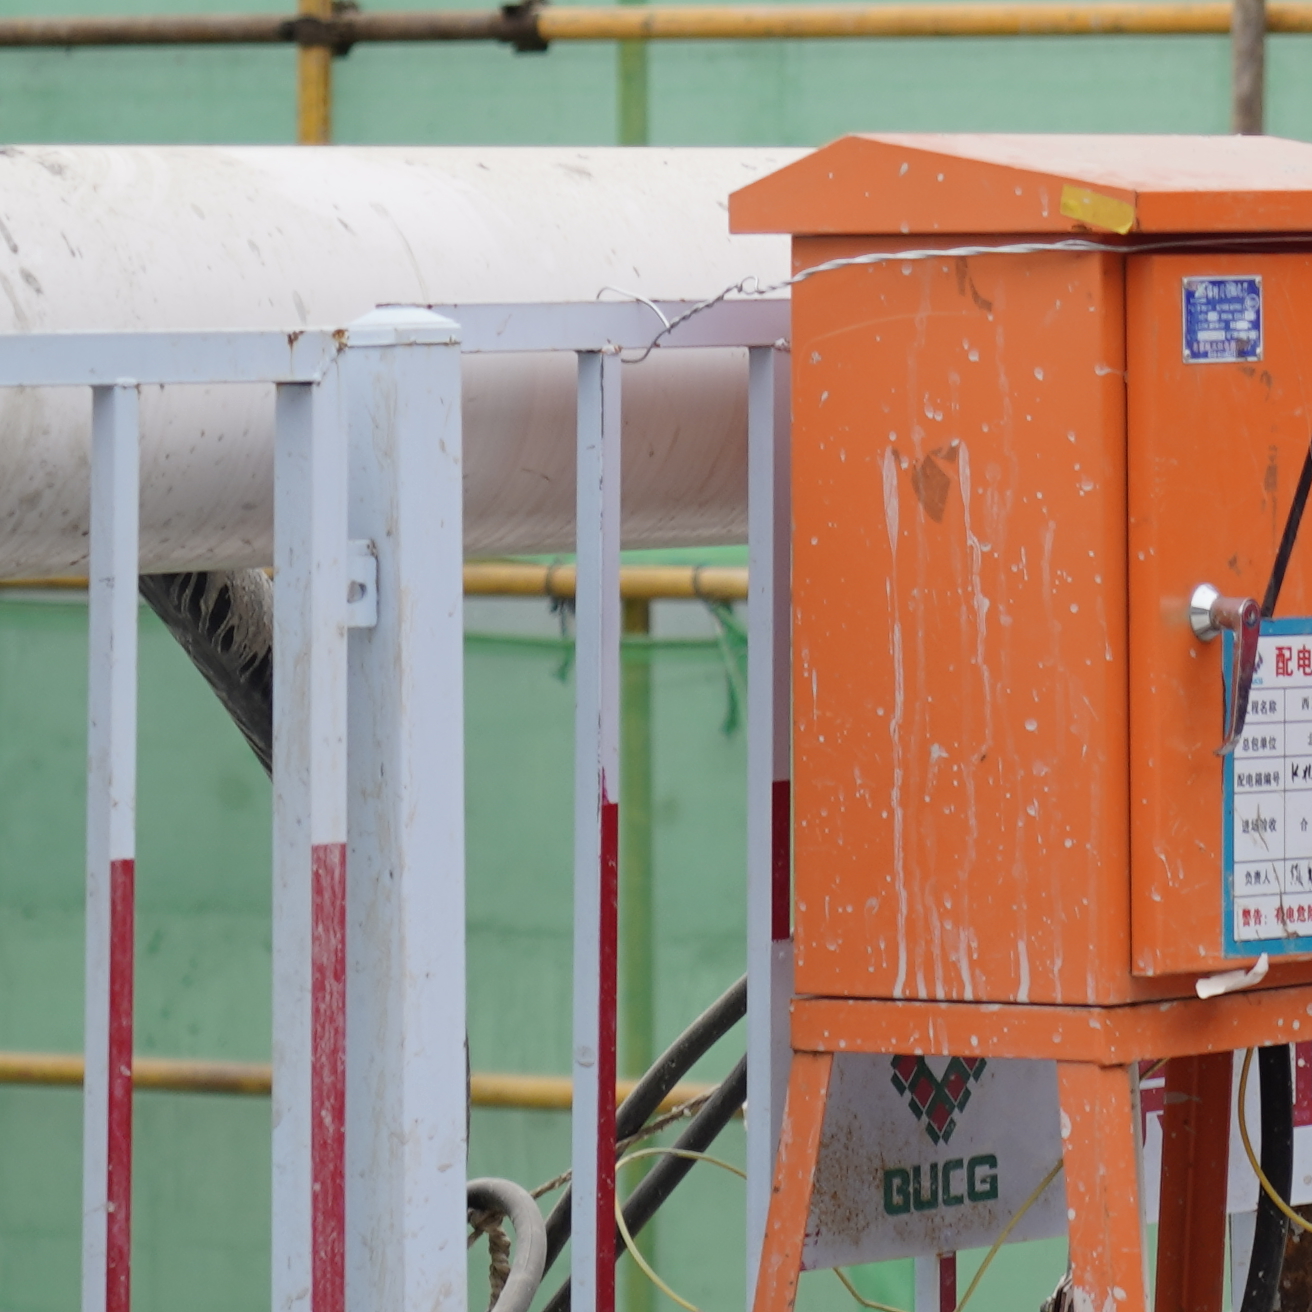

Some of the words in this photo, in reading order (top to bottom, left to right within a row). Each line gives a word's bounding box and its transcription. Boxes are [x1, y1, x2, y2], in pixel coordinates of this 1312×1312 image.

[1246, 699, 1277, 715] 程名称
[1242, 736, 1277, 752] 总包单位
[1236, 771, 1280, 787] 配电箱编号
[1242, 817, 1277, 834] 进场验收
[1245, 869, 1270, 886] 负责人
[883, 1154, 998, 1216] BUCG
